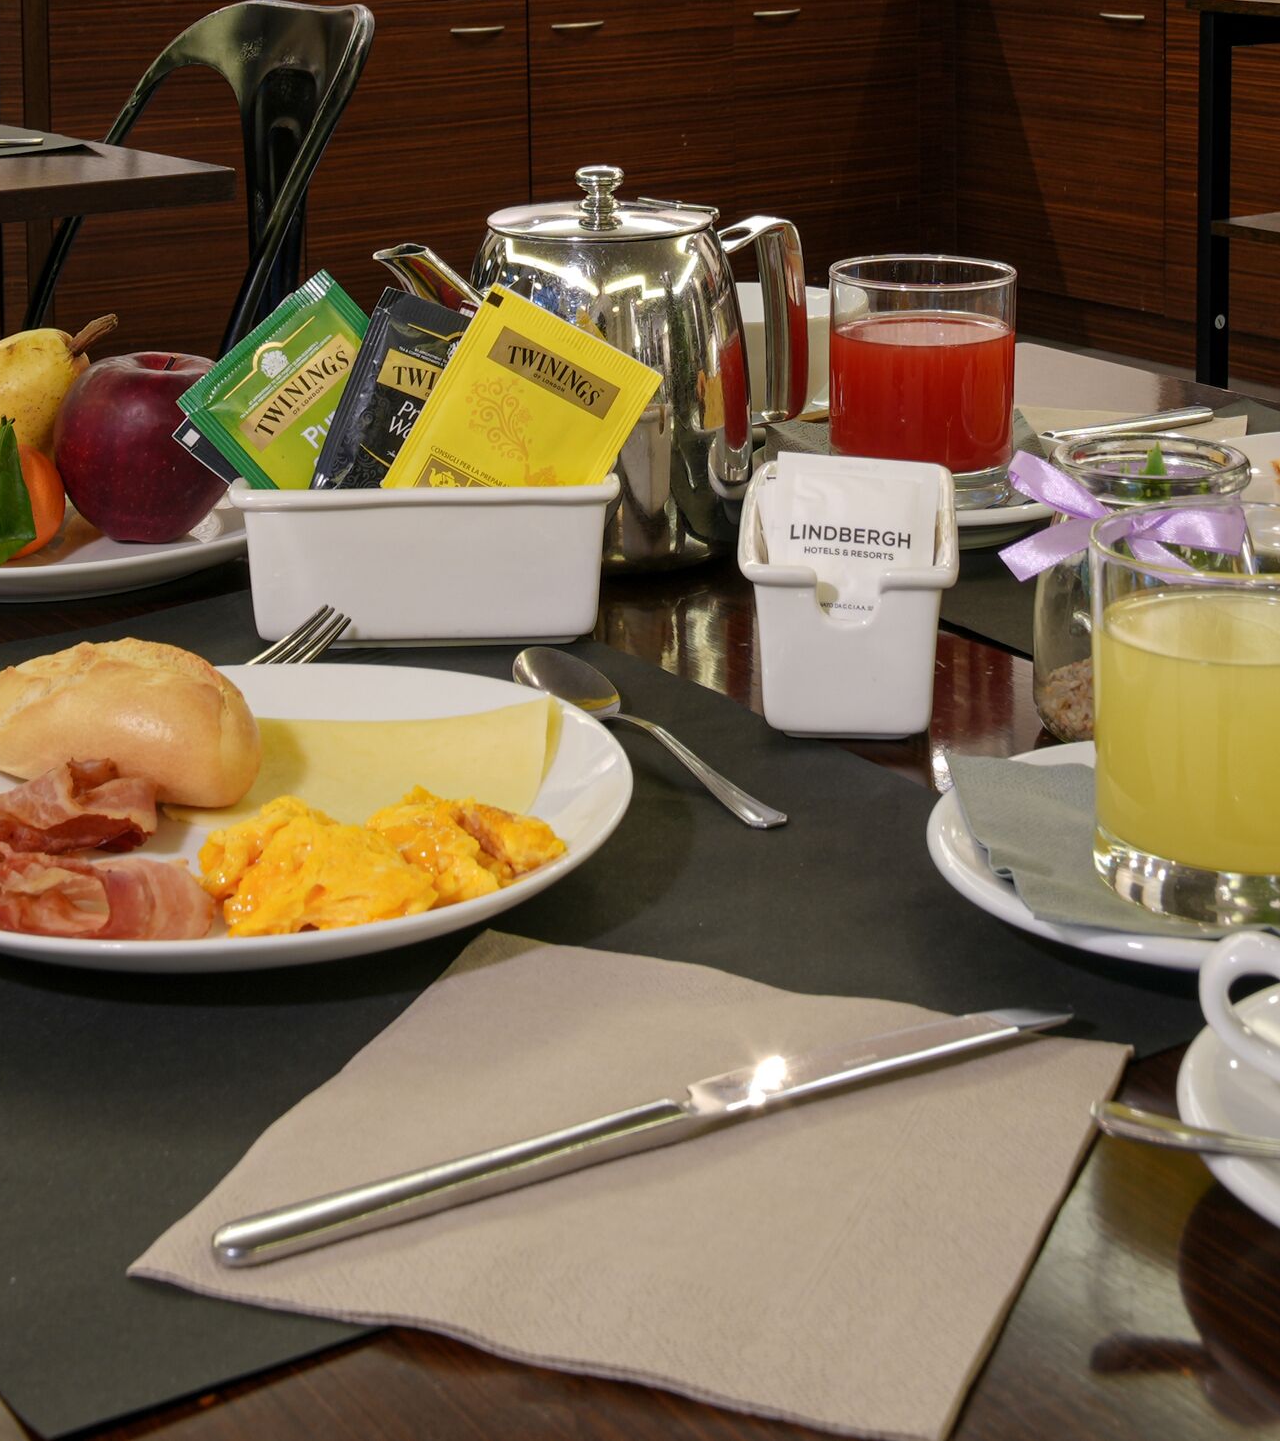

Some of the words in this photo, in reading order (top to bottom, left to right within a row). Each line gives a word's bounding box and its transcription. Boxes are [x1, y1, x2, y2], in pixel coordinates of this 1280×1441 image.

[507, 345, 601, 407] TWININGS
[532, 372, 542, 380] OF
[541, 377, 566, 394] LONDON
[253, 349, 350, 437] TWININGS
[292, 405, 302, 416] OF
[301, 384, 326, 408] LONDON
[430, 445, 461, 466] CONSIGLI
[459, 460, 471, 472] PER
[471, 466, 481, 476] LA
[789, 523, 912, 550] LINDBERGH
[803, 545, 841, 557] HOTELS
[842, 547, 849, 557] &
[850, 548, 895, 561] RESORTS
